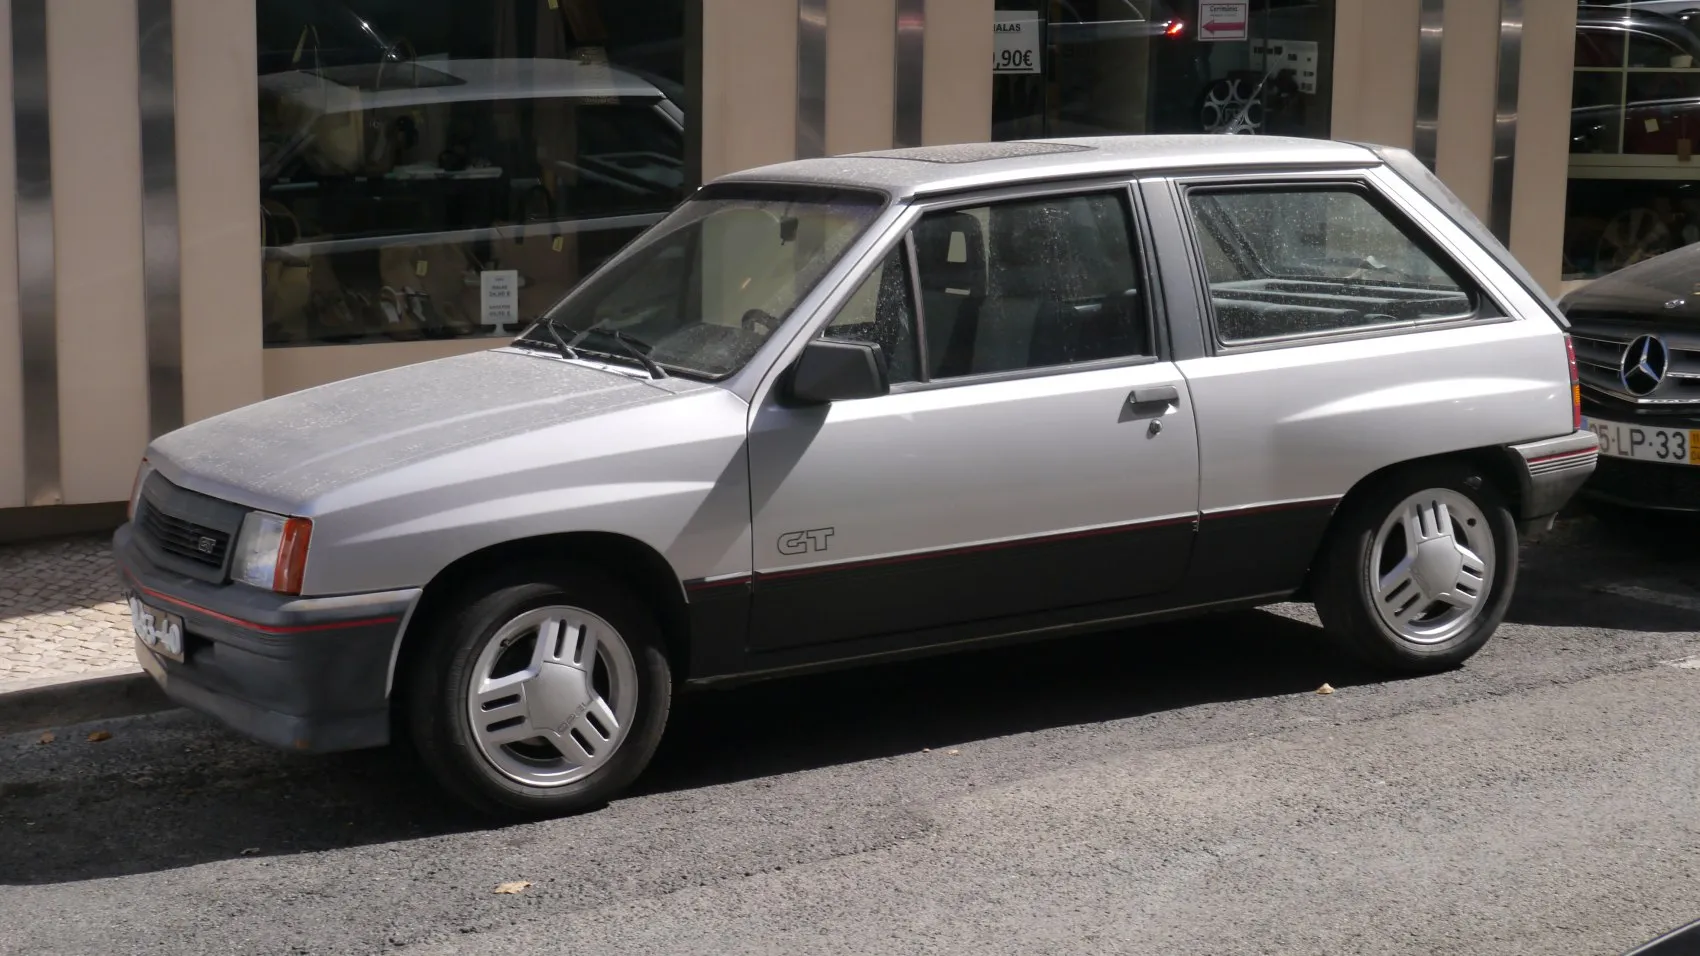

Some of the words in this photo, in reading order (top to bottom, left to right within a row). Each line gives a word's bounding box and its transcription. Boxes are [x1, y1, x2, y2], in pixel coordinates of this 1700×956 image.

[993, 49, 1033, 70] ,90€
[198, 536, 216, 554] GT
[777, 527, 834, 555] GT
